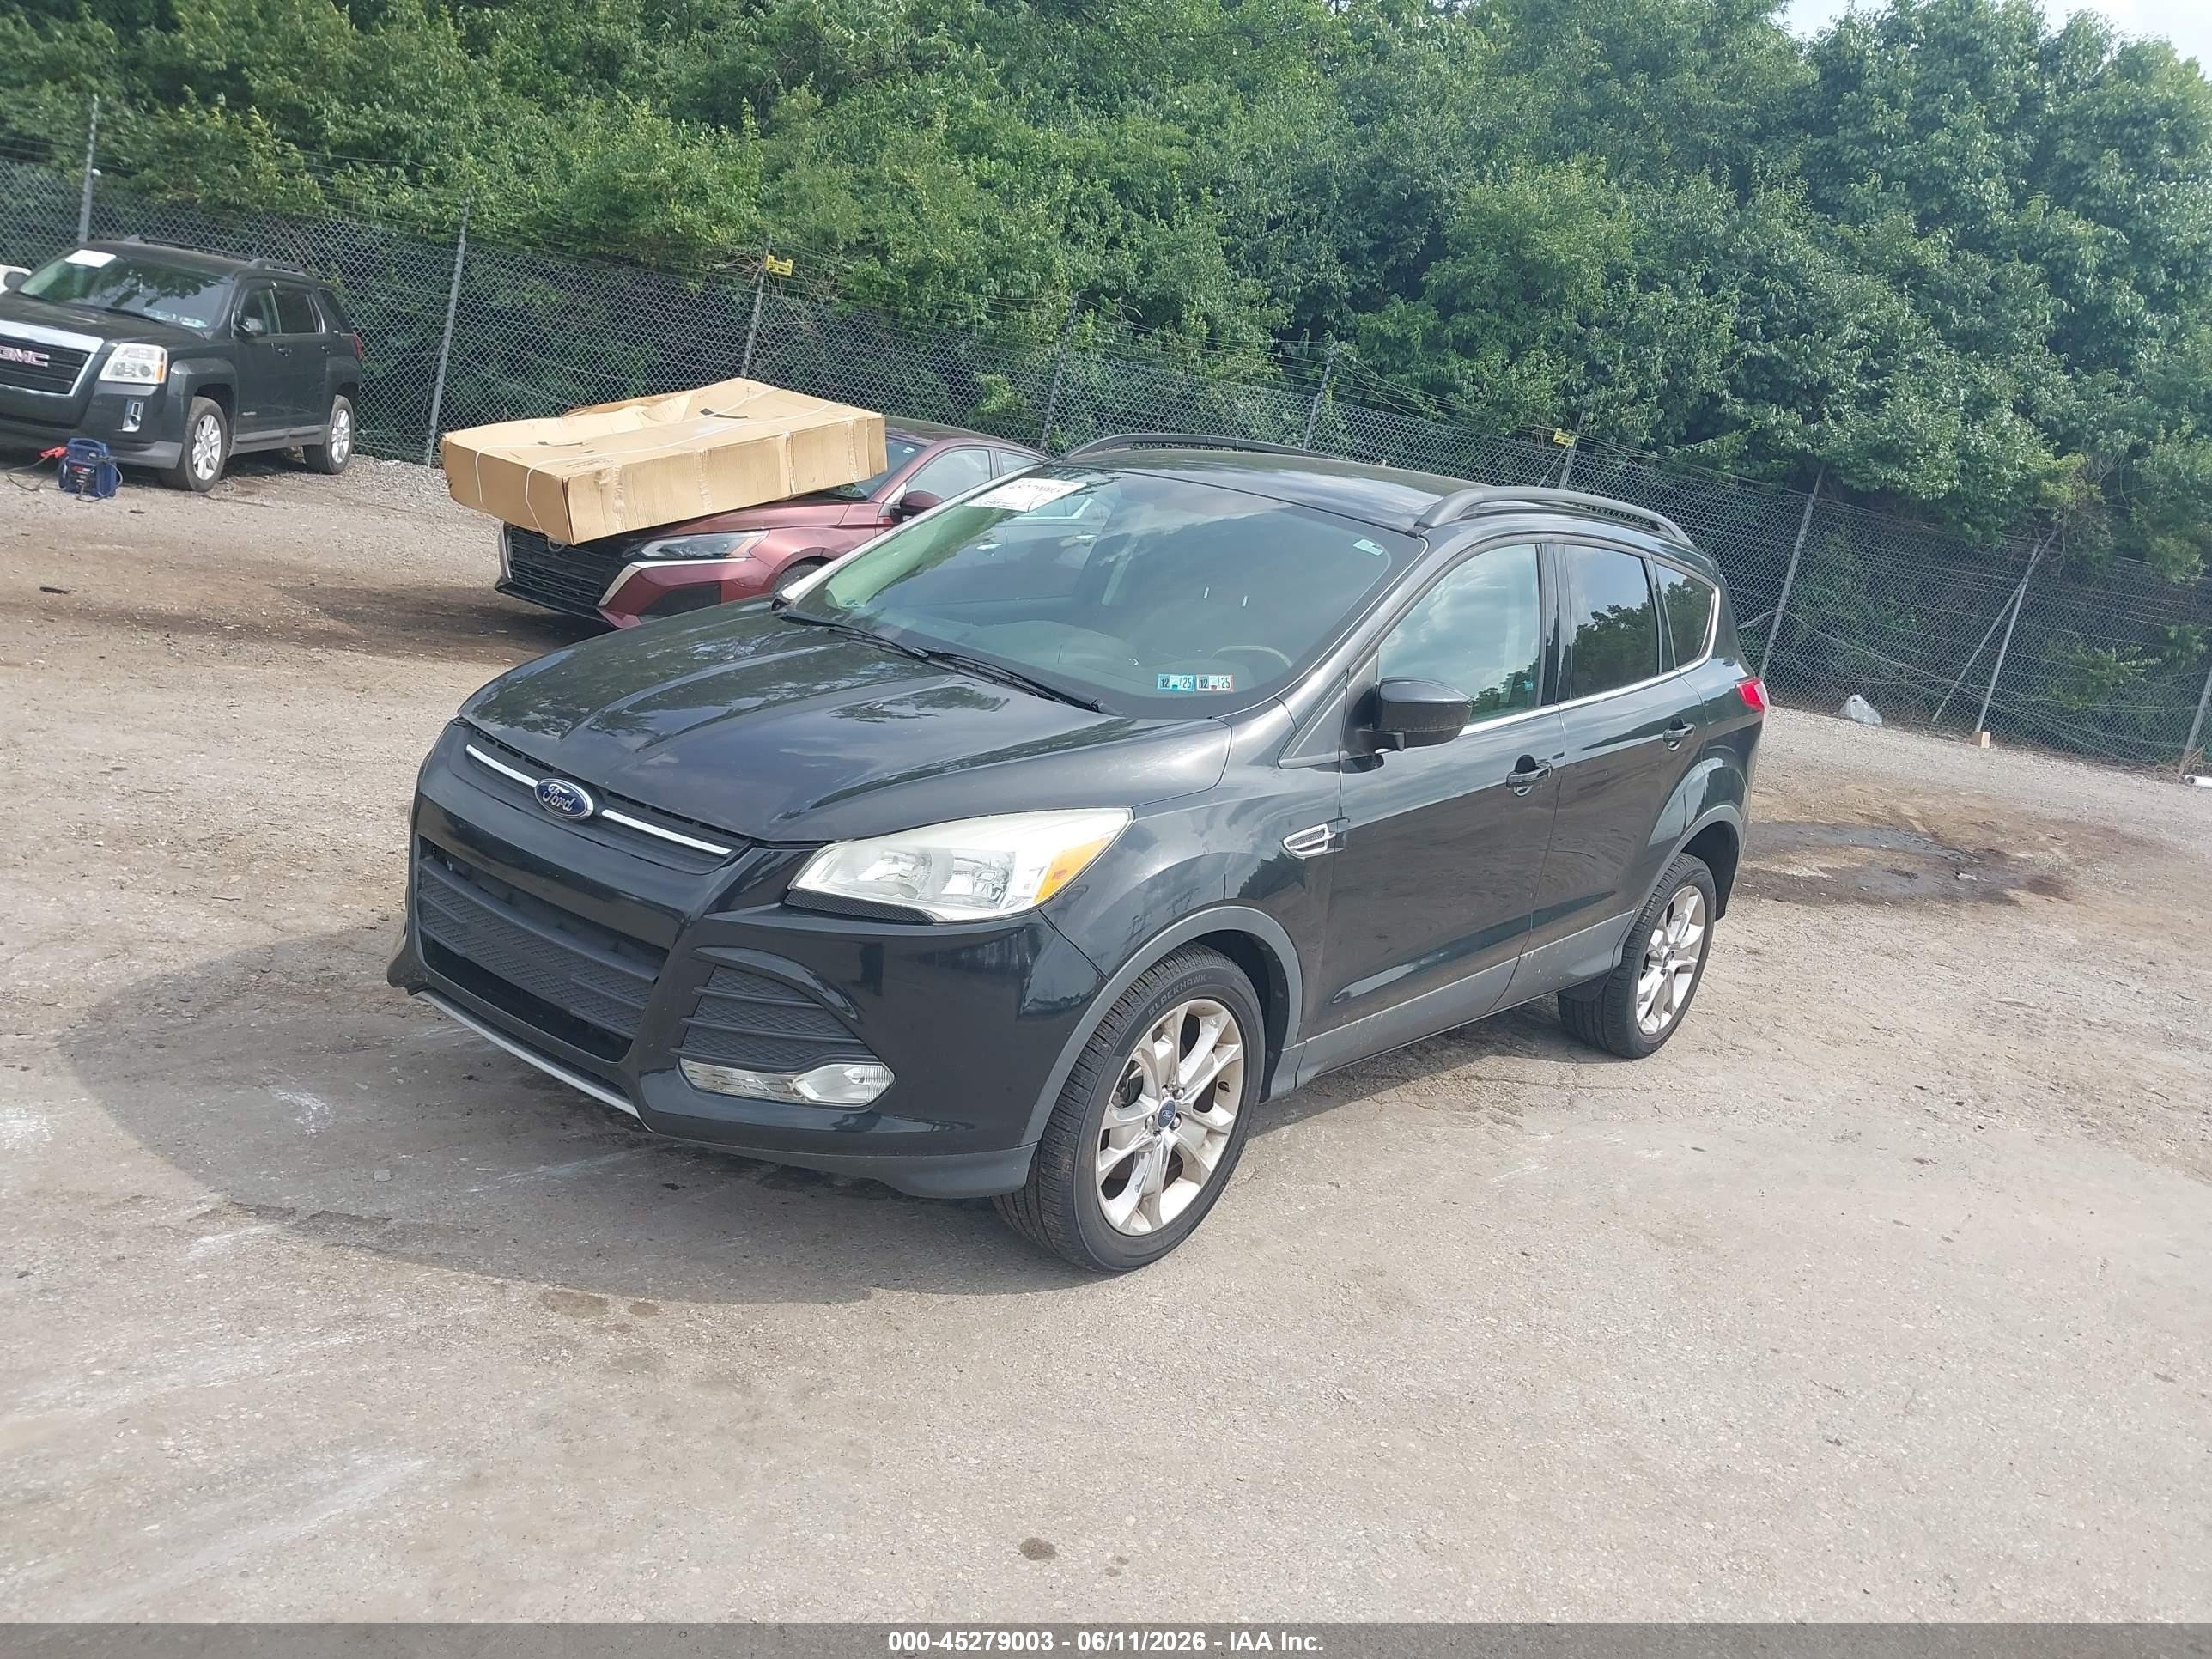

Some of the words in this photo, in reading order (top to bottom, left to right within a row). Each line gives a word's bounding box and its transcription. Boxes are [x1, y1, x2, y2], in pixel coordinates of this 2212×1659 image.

[1160, 678, 1170, 689] 12
[1182, 677, 1192, 689] 25
[1200, 678, 1208, 689] 12
[1221, 677, 1231, 689] 25
[542, 783, 577, 811] Ford
[1147, 974, 1207, 1018] BLACKHAWK
